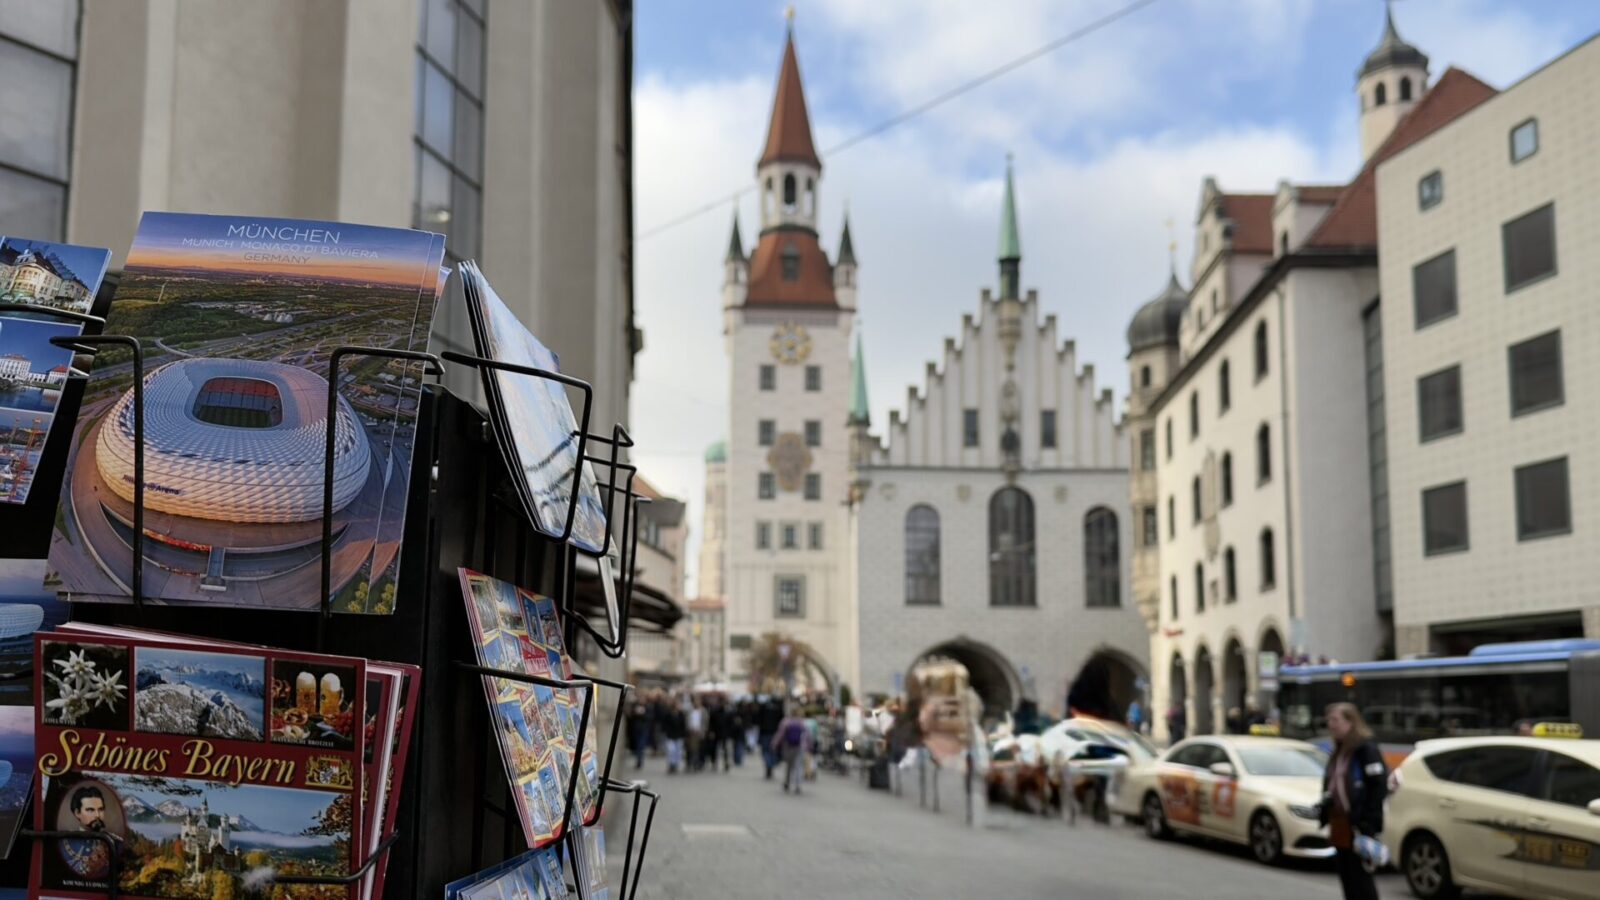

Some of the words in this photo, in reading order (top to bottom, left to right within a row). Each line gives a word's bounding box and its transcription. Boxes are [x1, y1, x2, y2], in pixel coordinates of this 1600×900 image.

[227, 224, 341, 244] MÜNCHEN
[182, 238, 234, 249] MUNICH
[241, 241, 300, 253] MONACO
[304, 244, 317, 254] DI
[321, 246, 379, 259] BAVIERA
[244, 252, 311, 265] GERMANY
[38, 729, 170, 777] Schönes
[182, 739, 296, 786] Bayern
